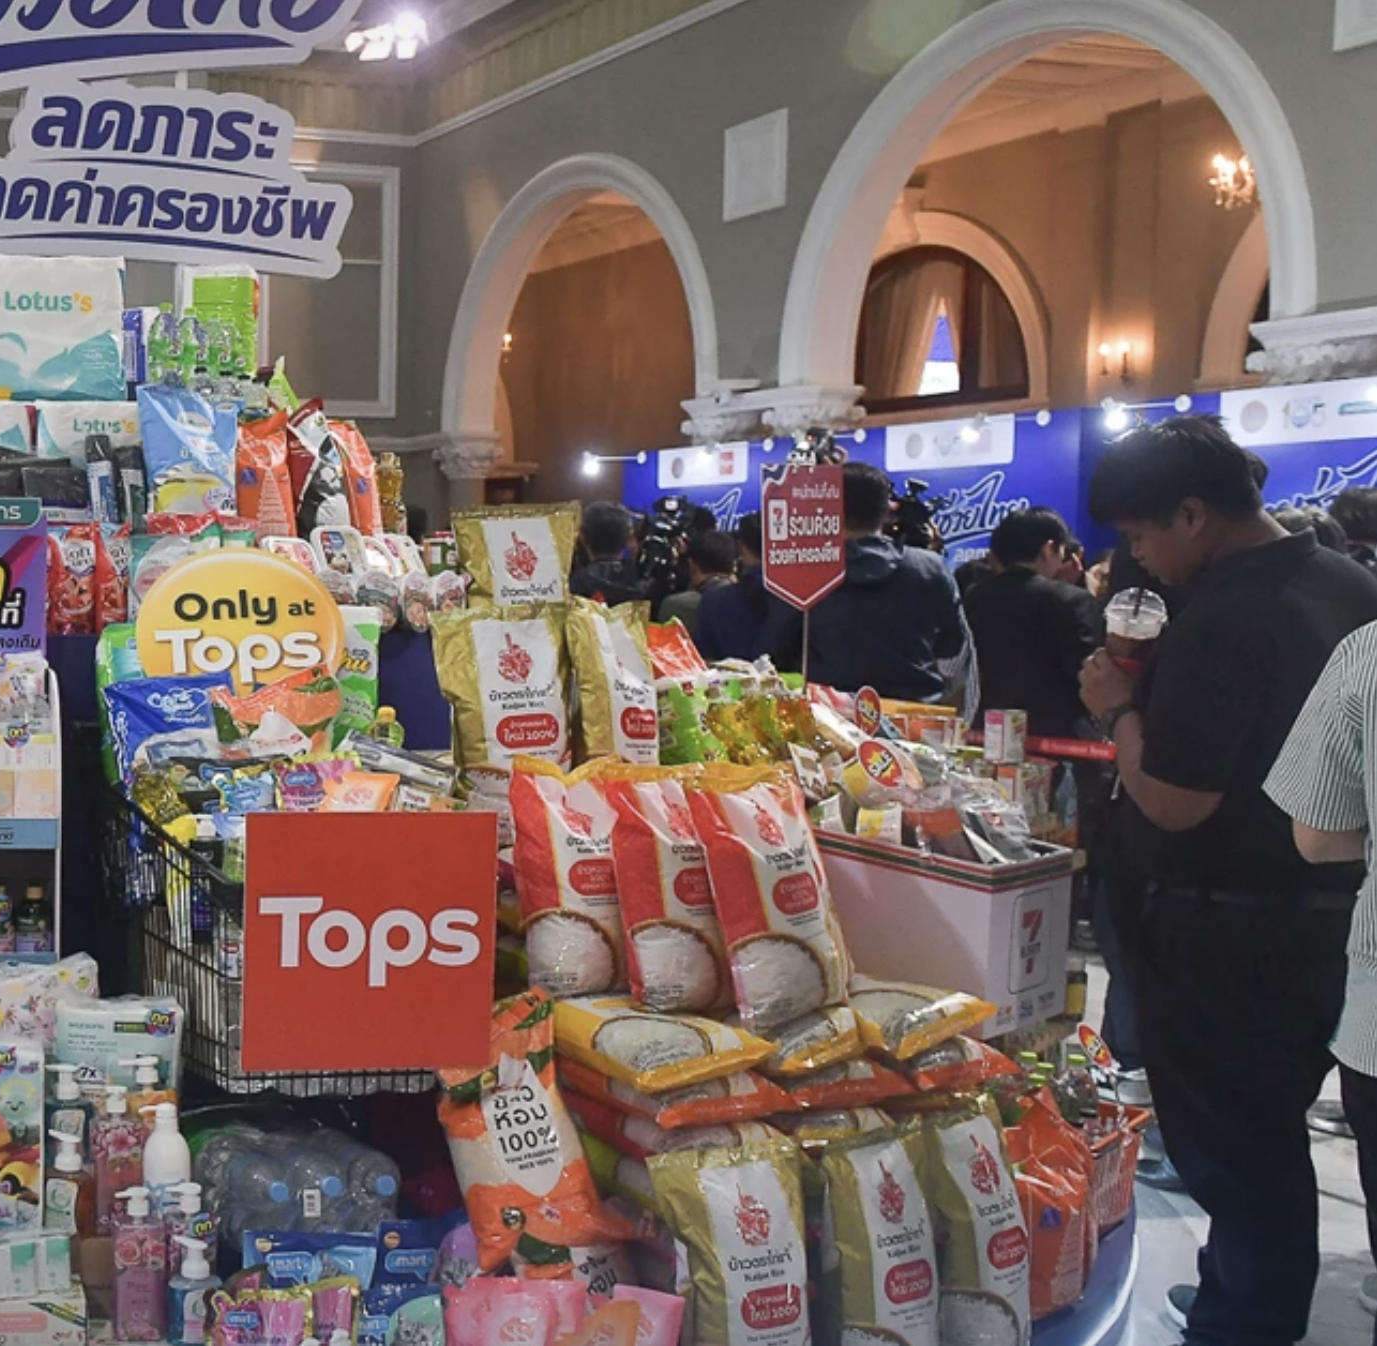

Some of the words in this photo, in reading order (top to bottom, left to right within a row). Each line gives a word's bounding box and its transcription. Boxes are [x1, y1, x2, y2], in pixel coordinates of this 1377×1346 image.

[31, 92, 280, 161] ลดภาระ
[4, 290, 93, 314] Lotus's
[173, 589, 278, 626] Only
[288, 600, 316, 618] at
[154, 629, 324, 684] Tops
[258, 896, 482, 988] Tops
[493, 1103, 548, 1131] หอม
[498, 1125, 558, 1155] 100%
